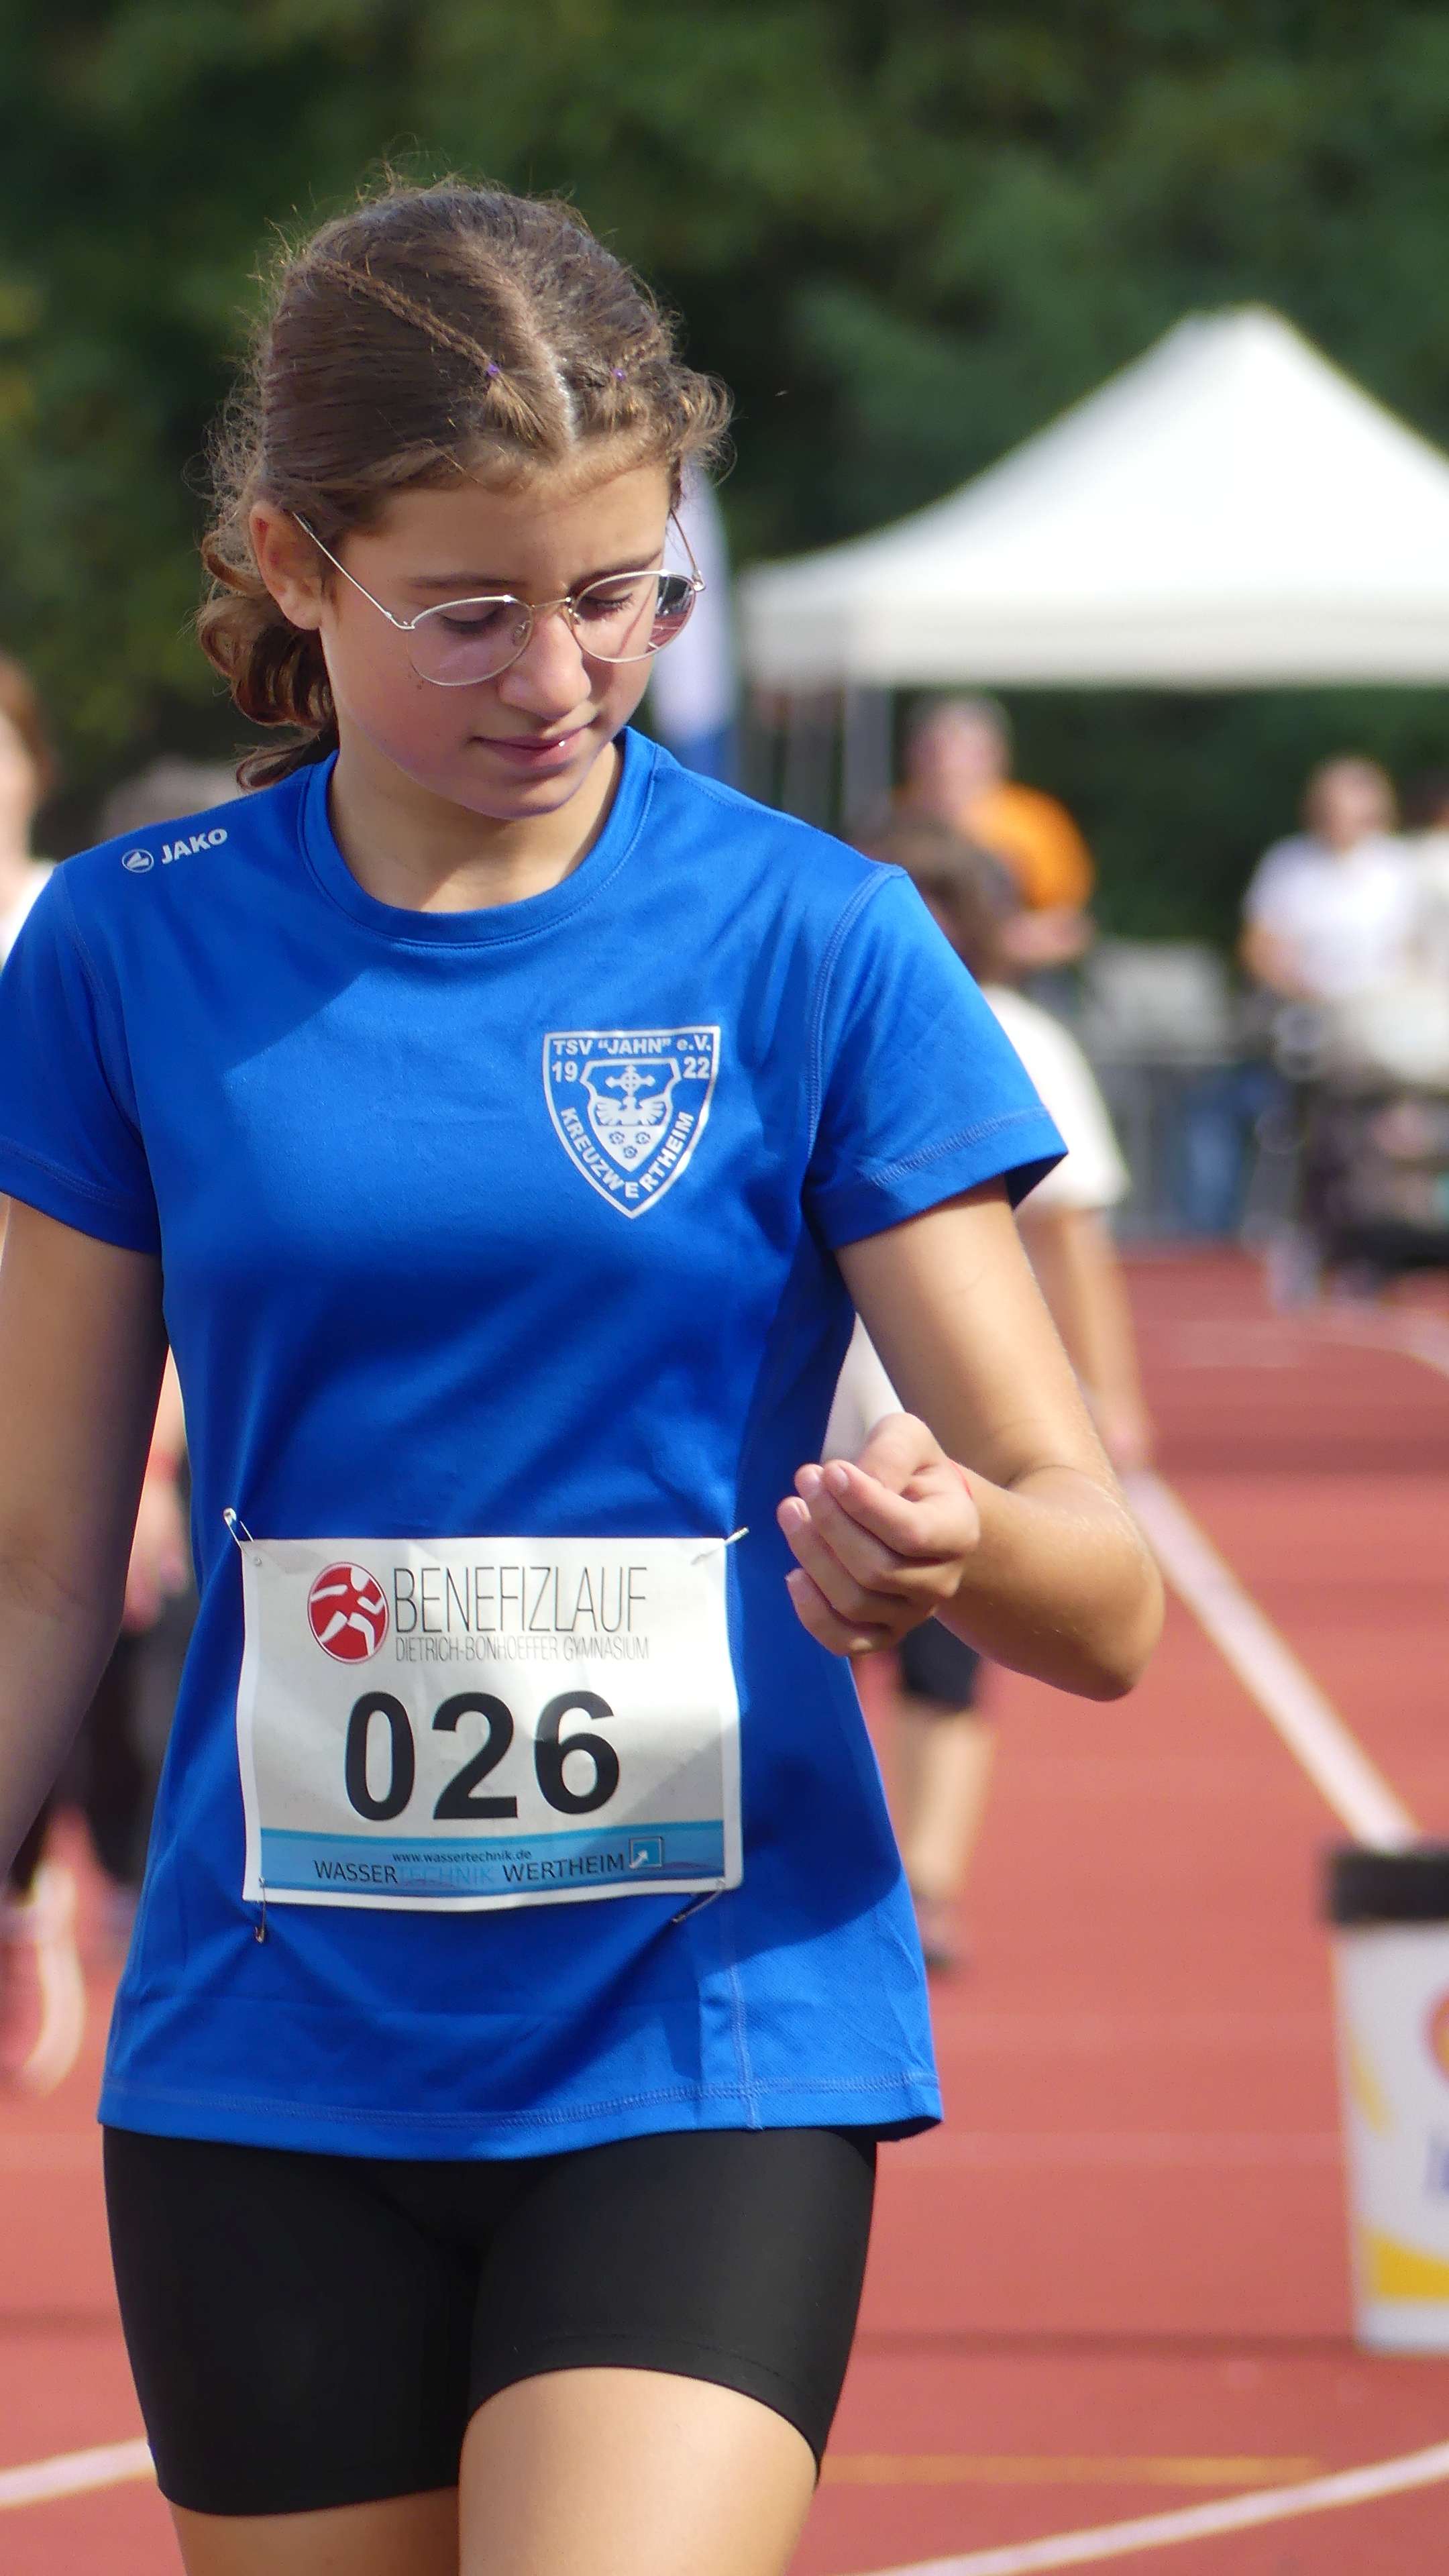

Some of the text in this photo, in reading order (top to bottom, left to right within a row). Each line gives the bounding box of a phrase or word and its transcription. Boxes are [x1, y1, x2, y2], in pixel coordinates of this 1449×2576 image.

[160, 828, 228, 865] JAKO
[553, 1040, 593, 1055] TSV
[676, 1034, 712, 1051] e.V.
[551, 1056, 710, 1083] 19 22
[561, 1107, 694, 1199] KREUZWERTHEIM
[394, 1566, 648, 1633] BENEFIZLAUF
[395, 1635, 650, 1662] DIETRICH-BONHOEFFER GYMNASIUM
[344, 1690, 620, 1821] 026
[392, 1847, 531, 1863] www.wassertechnik.de
[502, 1853, 624, 1884] WERTHEIM
